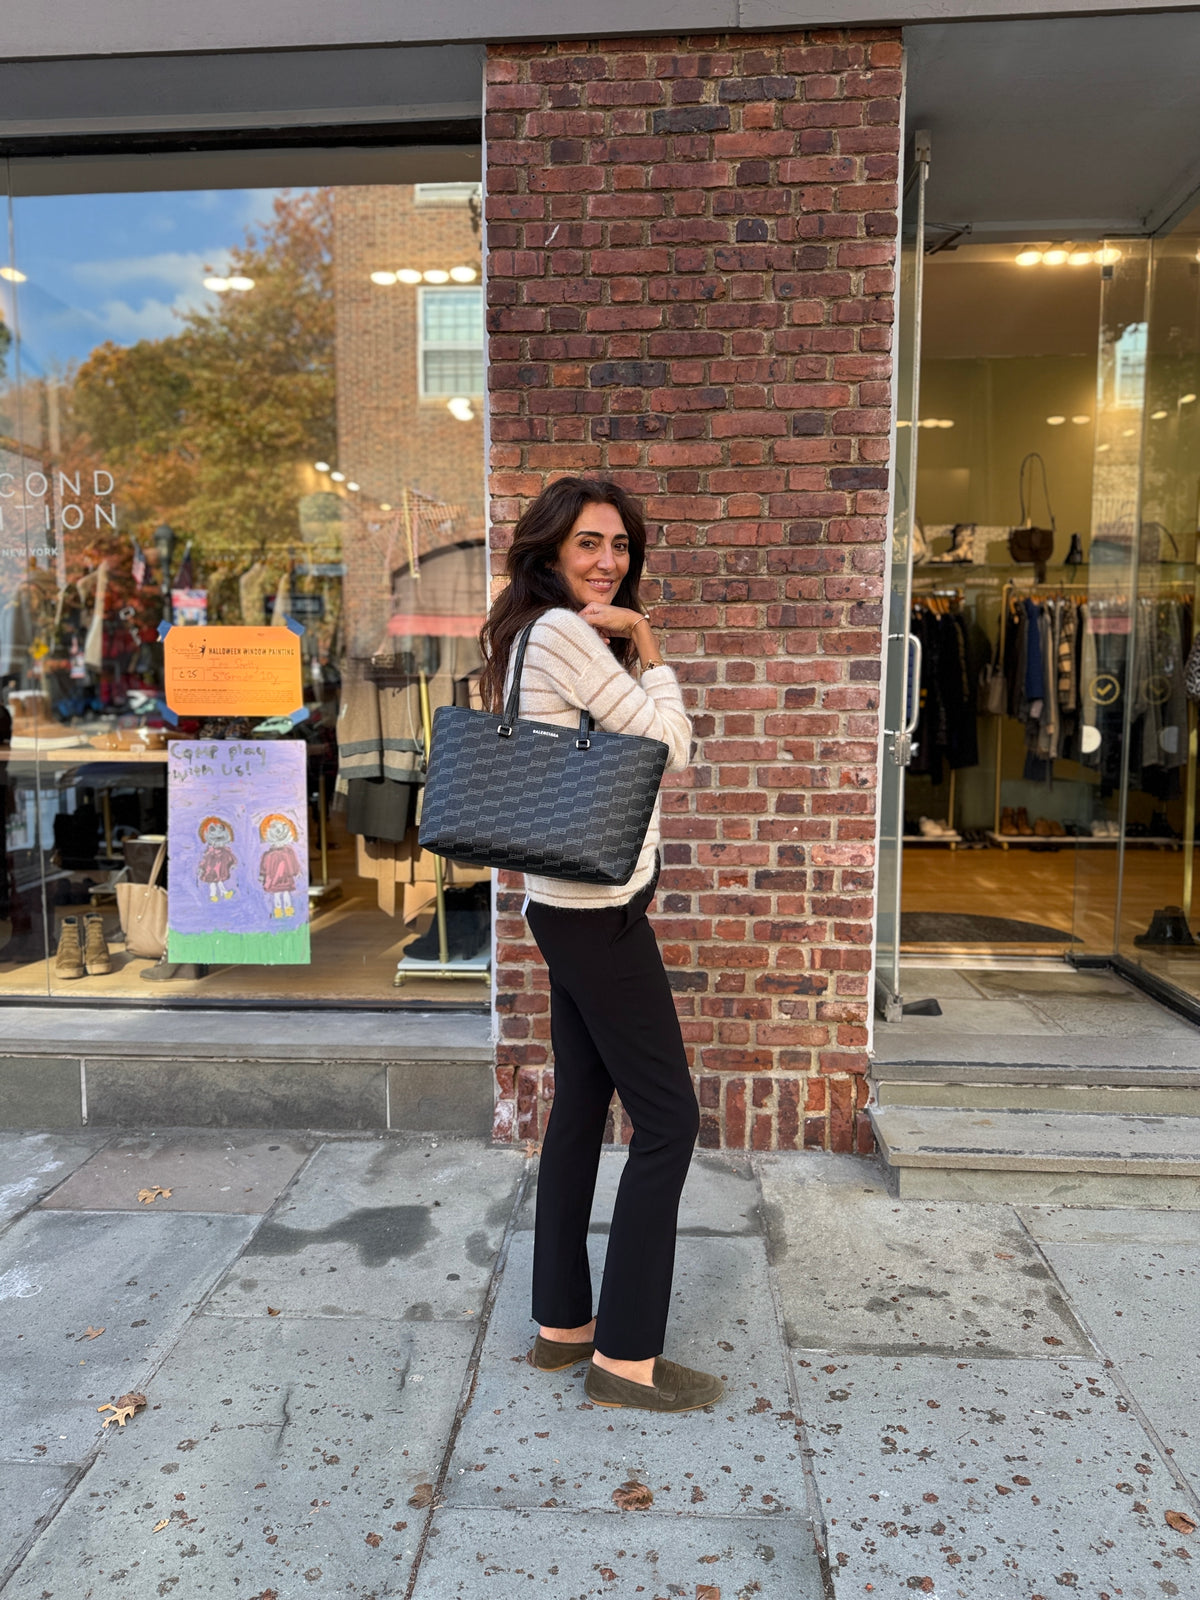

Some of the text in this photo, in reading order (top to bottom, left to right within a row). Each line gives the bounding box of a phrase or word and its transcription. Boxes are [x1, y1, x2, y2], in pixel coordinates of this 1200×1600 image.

[2, 547, 58, 557] NEW YORK
[208, 647, 241, 655] HALLOWEEN
[243, 647, 267, 656] WINDOW
[269, 648, 295, 656] PAINTING
